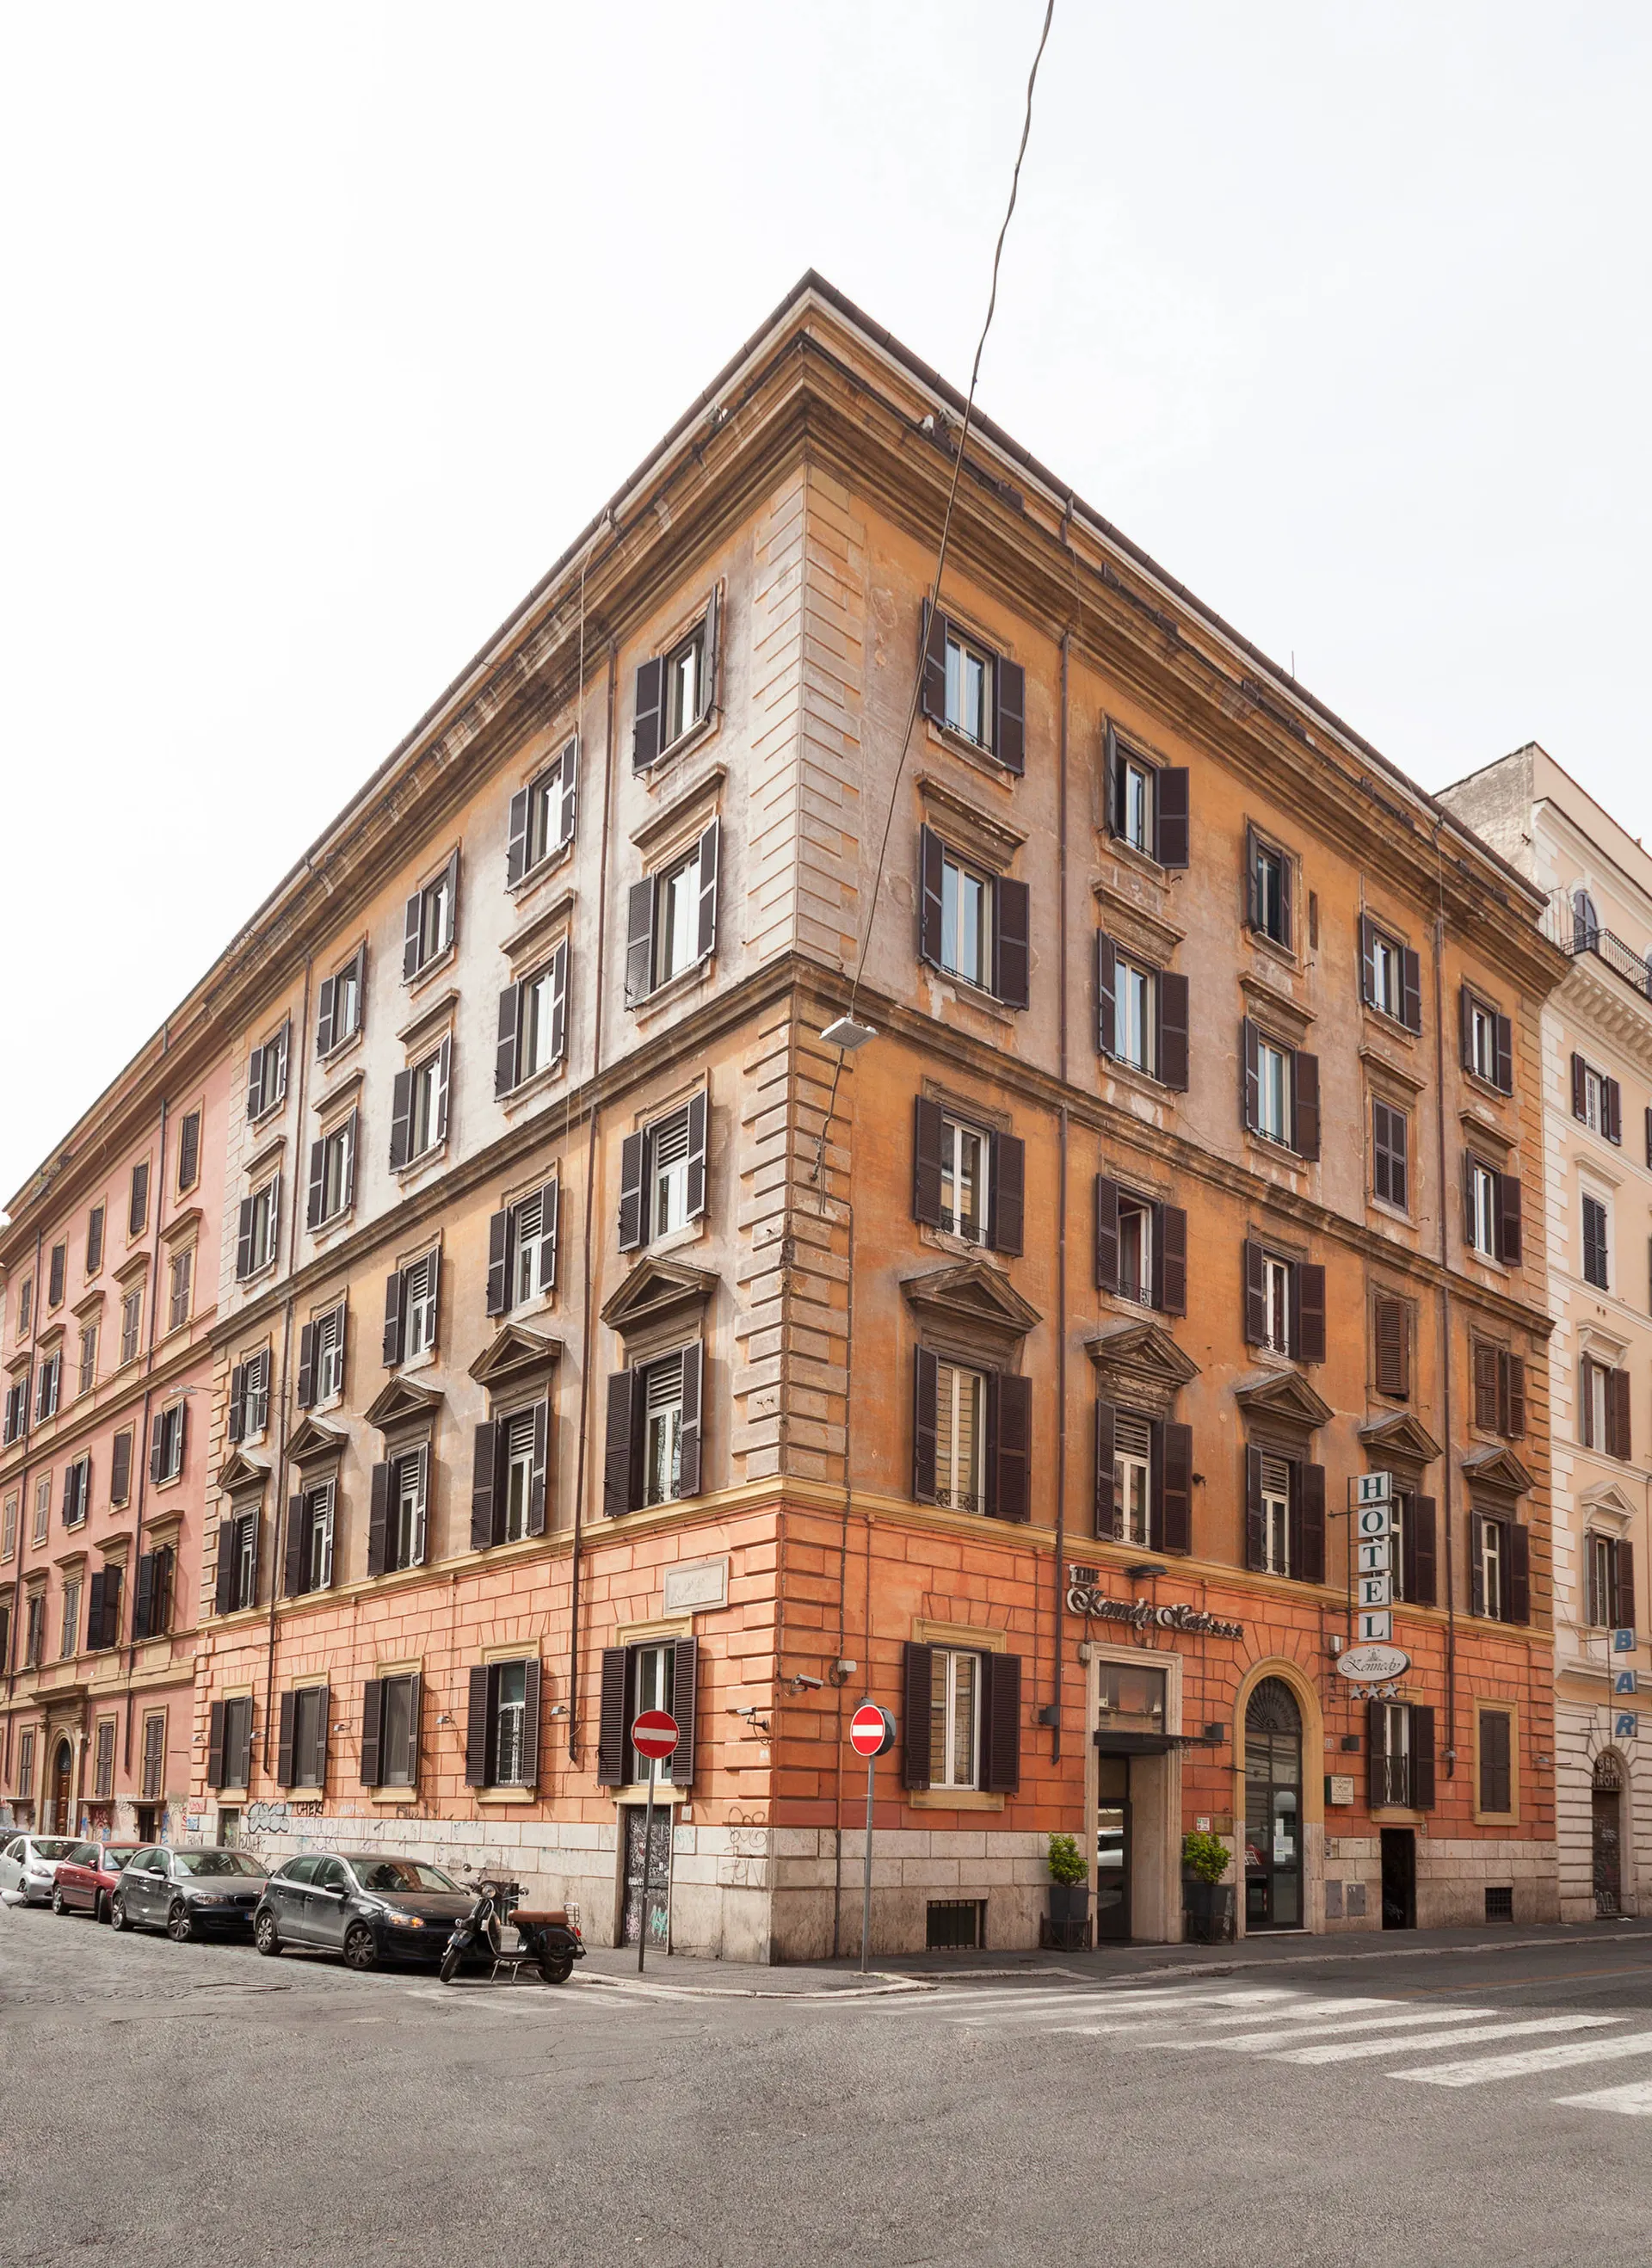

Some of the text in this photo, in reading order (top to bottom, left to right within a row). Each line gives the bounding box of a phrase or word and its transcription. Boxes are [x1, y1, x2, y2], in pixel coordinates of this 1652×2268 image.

[1360, 1475, 1384, 1639] HOTEL
[1341, 1658, 1401, 1675] Kennedy
[1614, 1629, 1635, 1735] BAR
